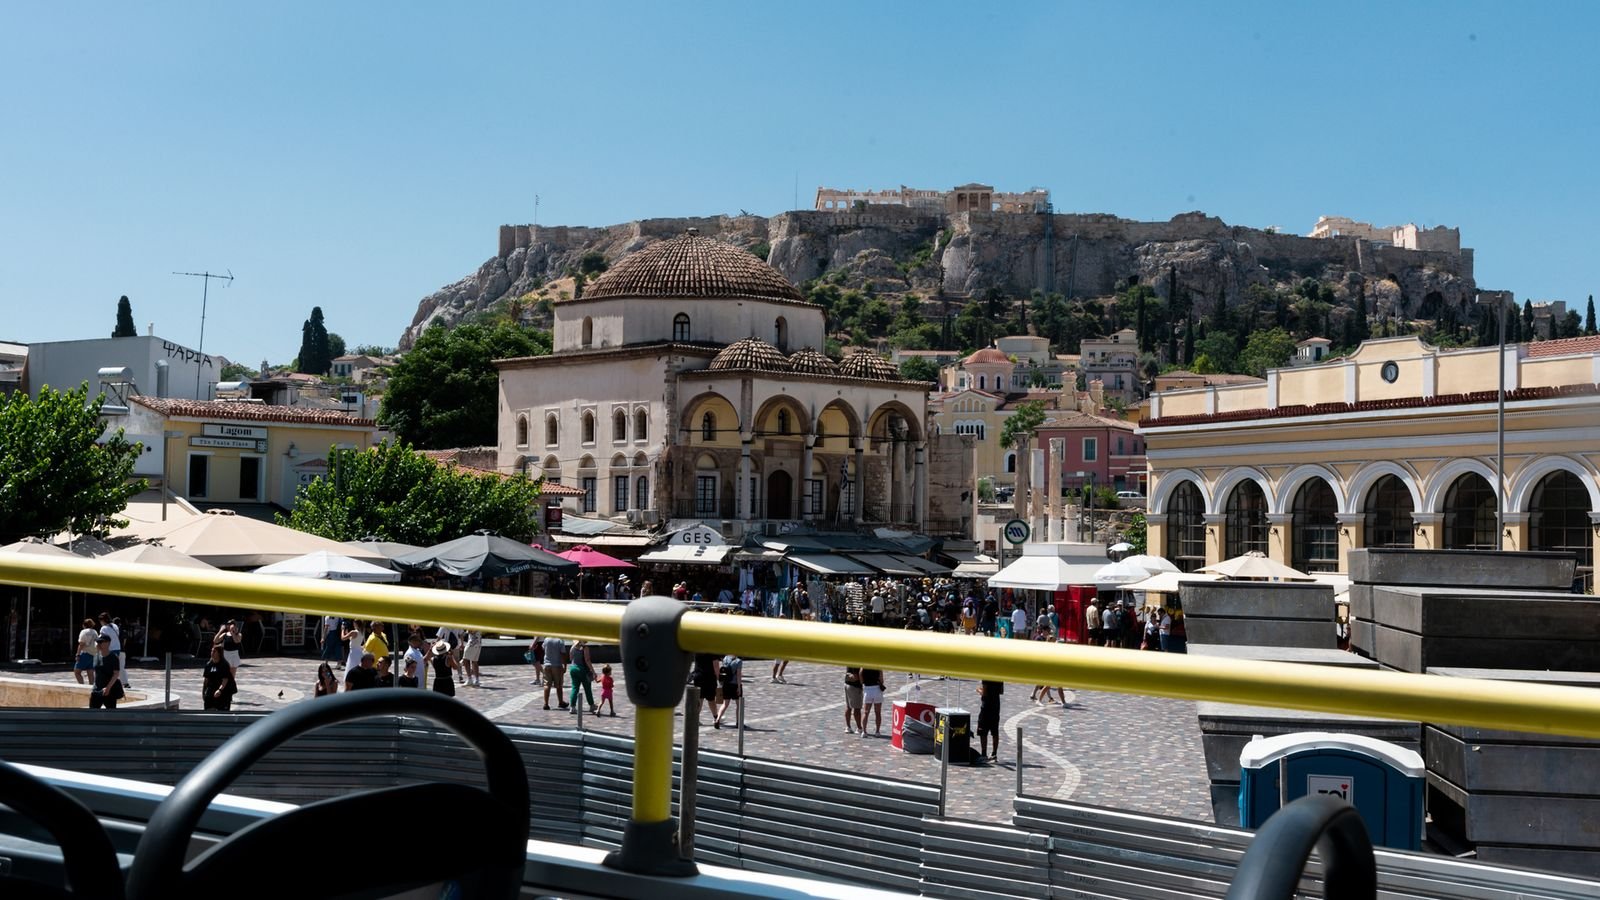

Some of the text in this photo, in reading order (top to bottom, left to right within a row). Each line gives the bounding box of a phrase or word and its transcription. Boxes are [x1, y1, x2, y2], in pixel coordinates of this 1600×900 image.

[220, 425, 252, 436] Lagom
[682, 532, 712, 544] GES
[505, 563, 530, 574] Lagom
